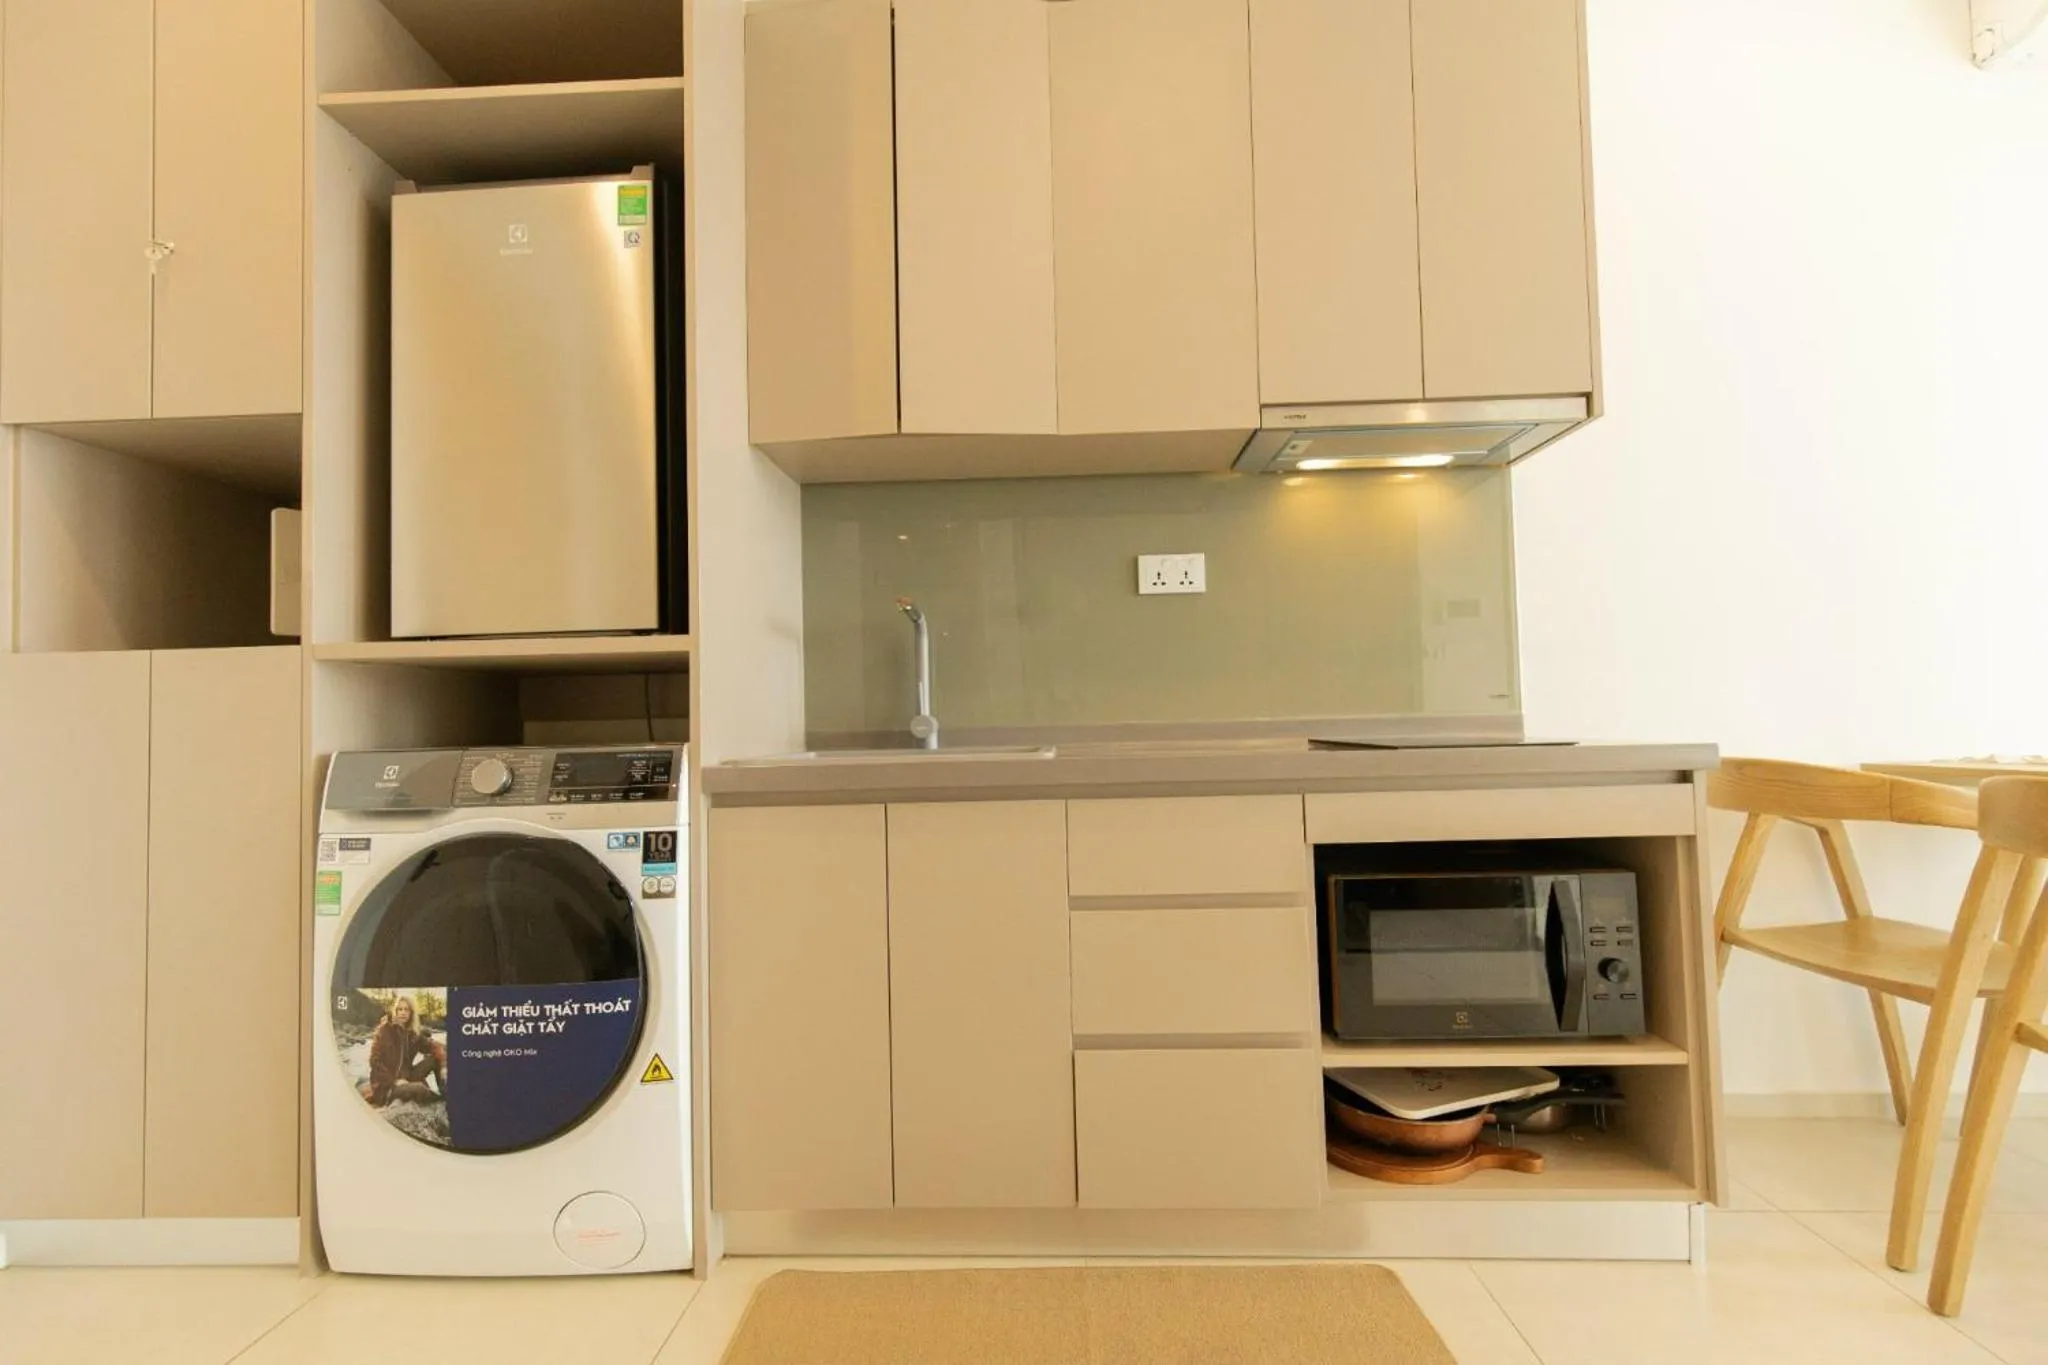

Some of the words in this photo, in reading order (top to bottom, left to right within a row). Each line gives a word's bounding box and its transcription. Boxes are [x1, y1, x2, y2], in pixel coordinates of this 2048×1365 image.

[647, 833, 673, 852] 10
[462, 1001, 498, 1018] GIẢM
[543, 998, 580, 1017] THẤT
[583, 997, 632, 1015] THOÁT
[462, 1018, 499, 1036] CHẤT
[461, 1048, 482, 1059] Công
